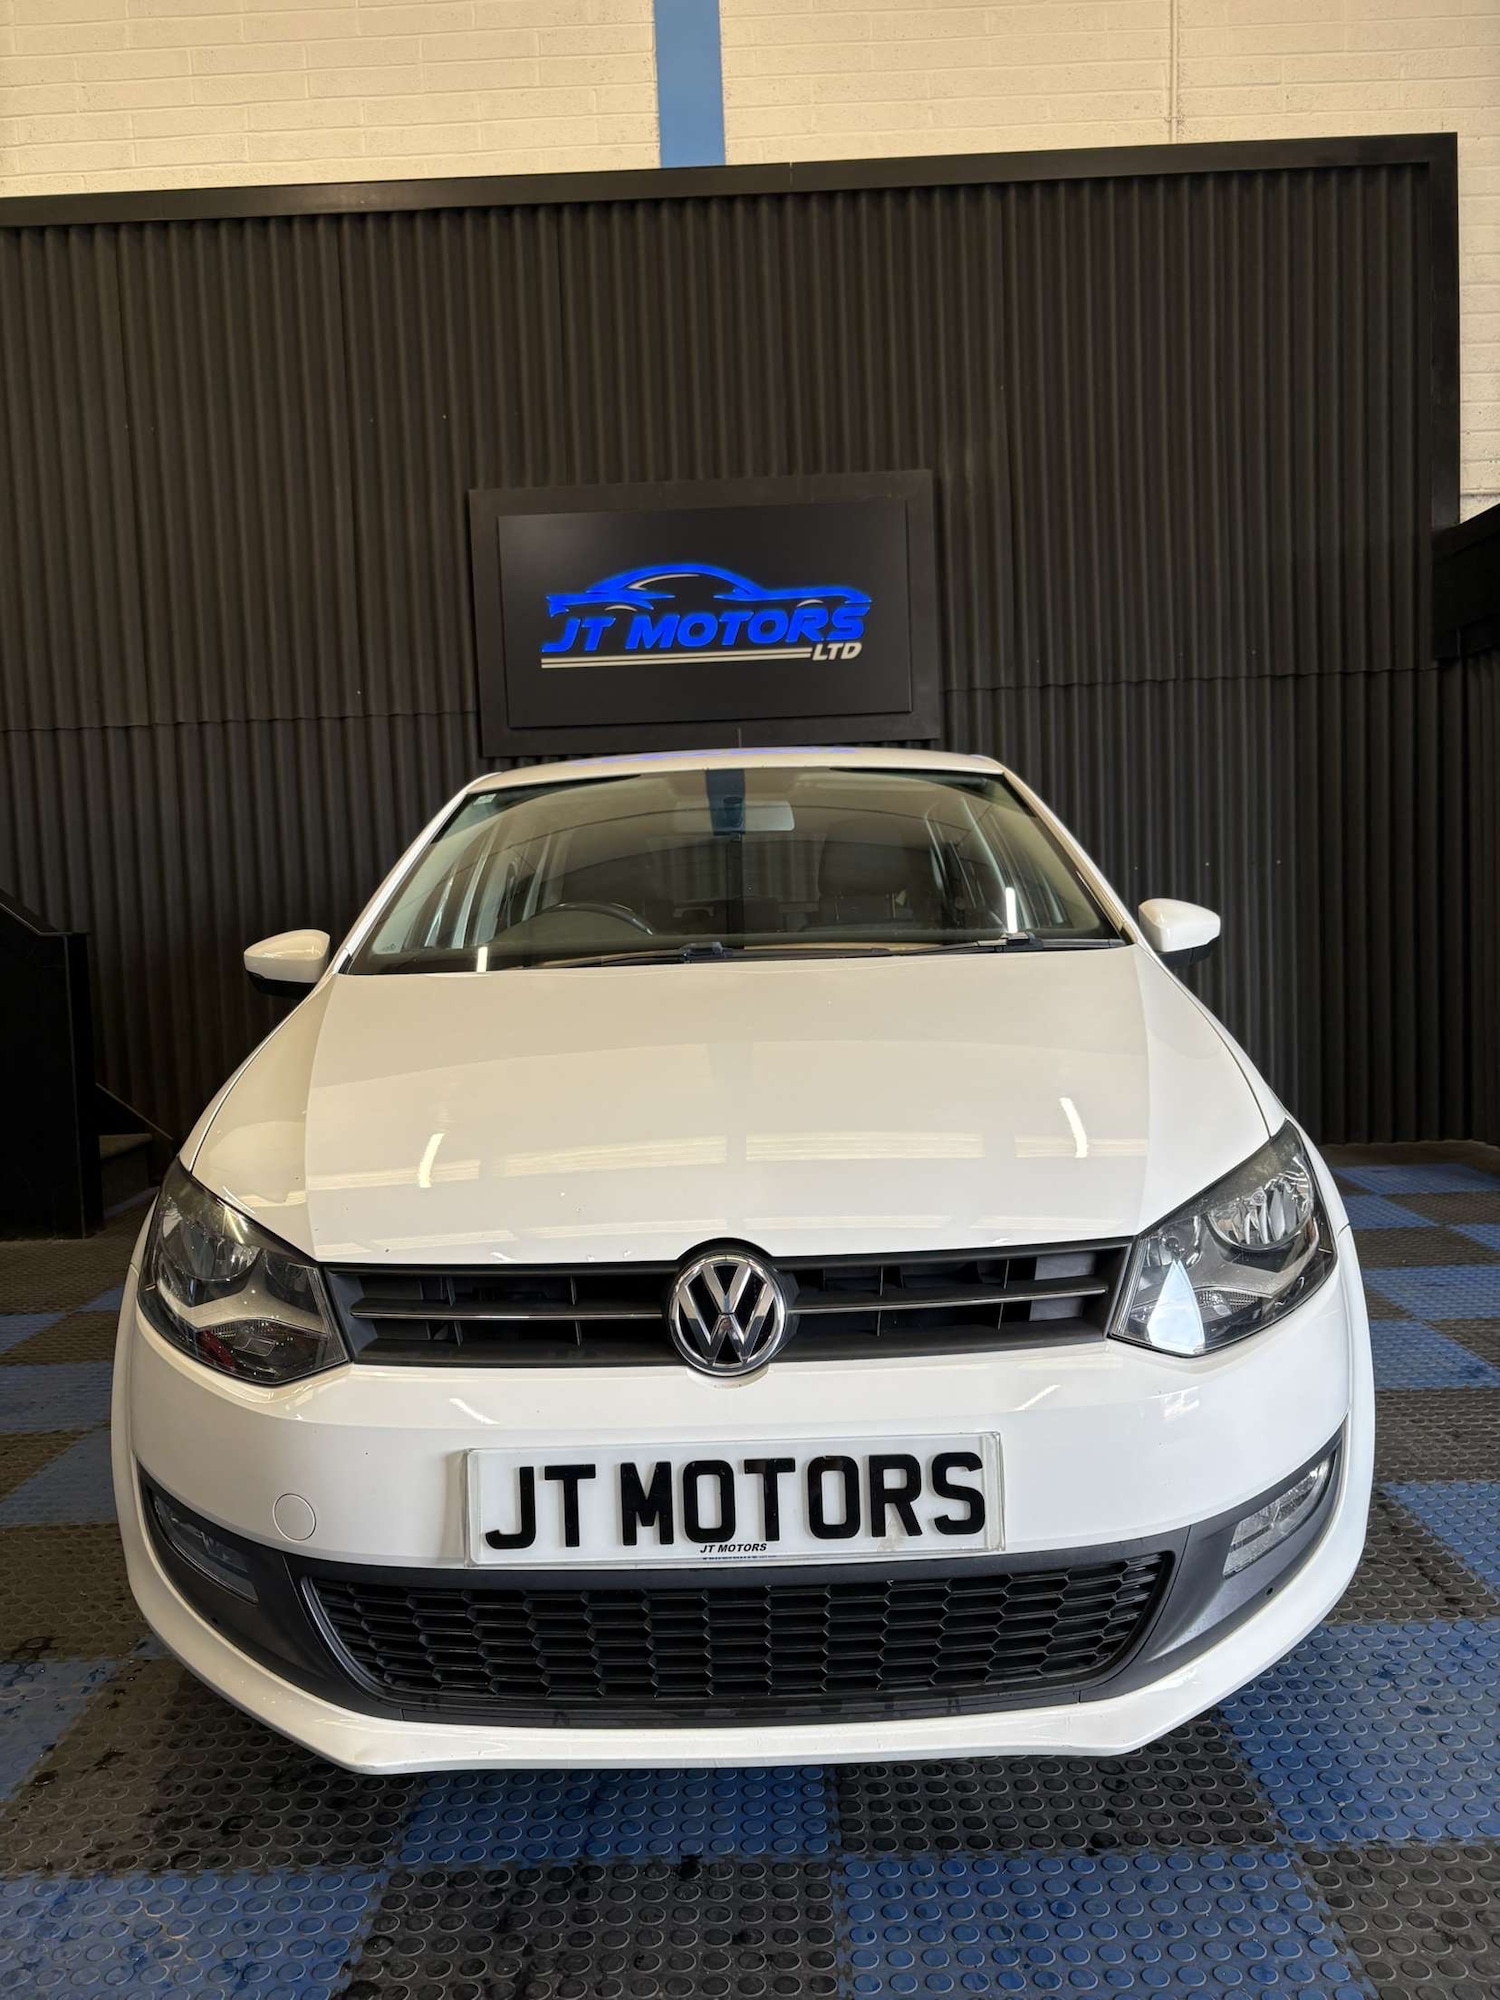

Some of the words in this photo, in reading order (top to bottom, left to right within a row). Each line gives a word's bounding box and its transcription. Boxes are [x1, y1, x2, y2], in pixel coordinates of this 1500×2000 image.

[541, 616, 617, 653] JT
[624, 607, 870, 650] MOTORS
[811, 642, 863, 662] LTD
[485, 1463, 596, 1550] JT
[620, 1451, 986, 1546] MOTORS
[700, 1544, 716, 1553] JT
[717, 1543, 768, 1553] MOTORS
